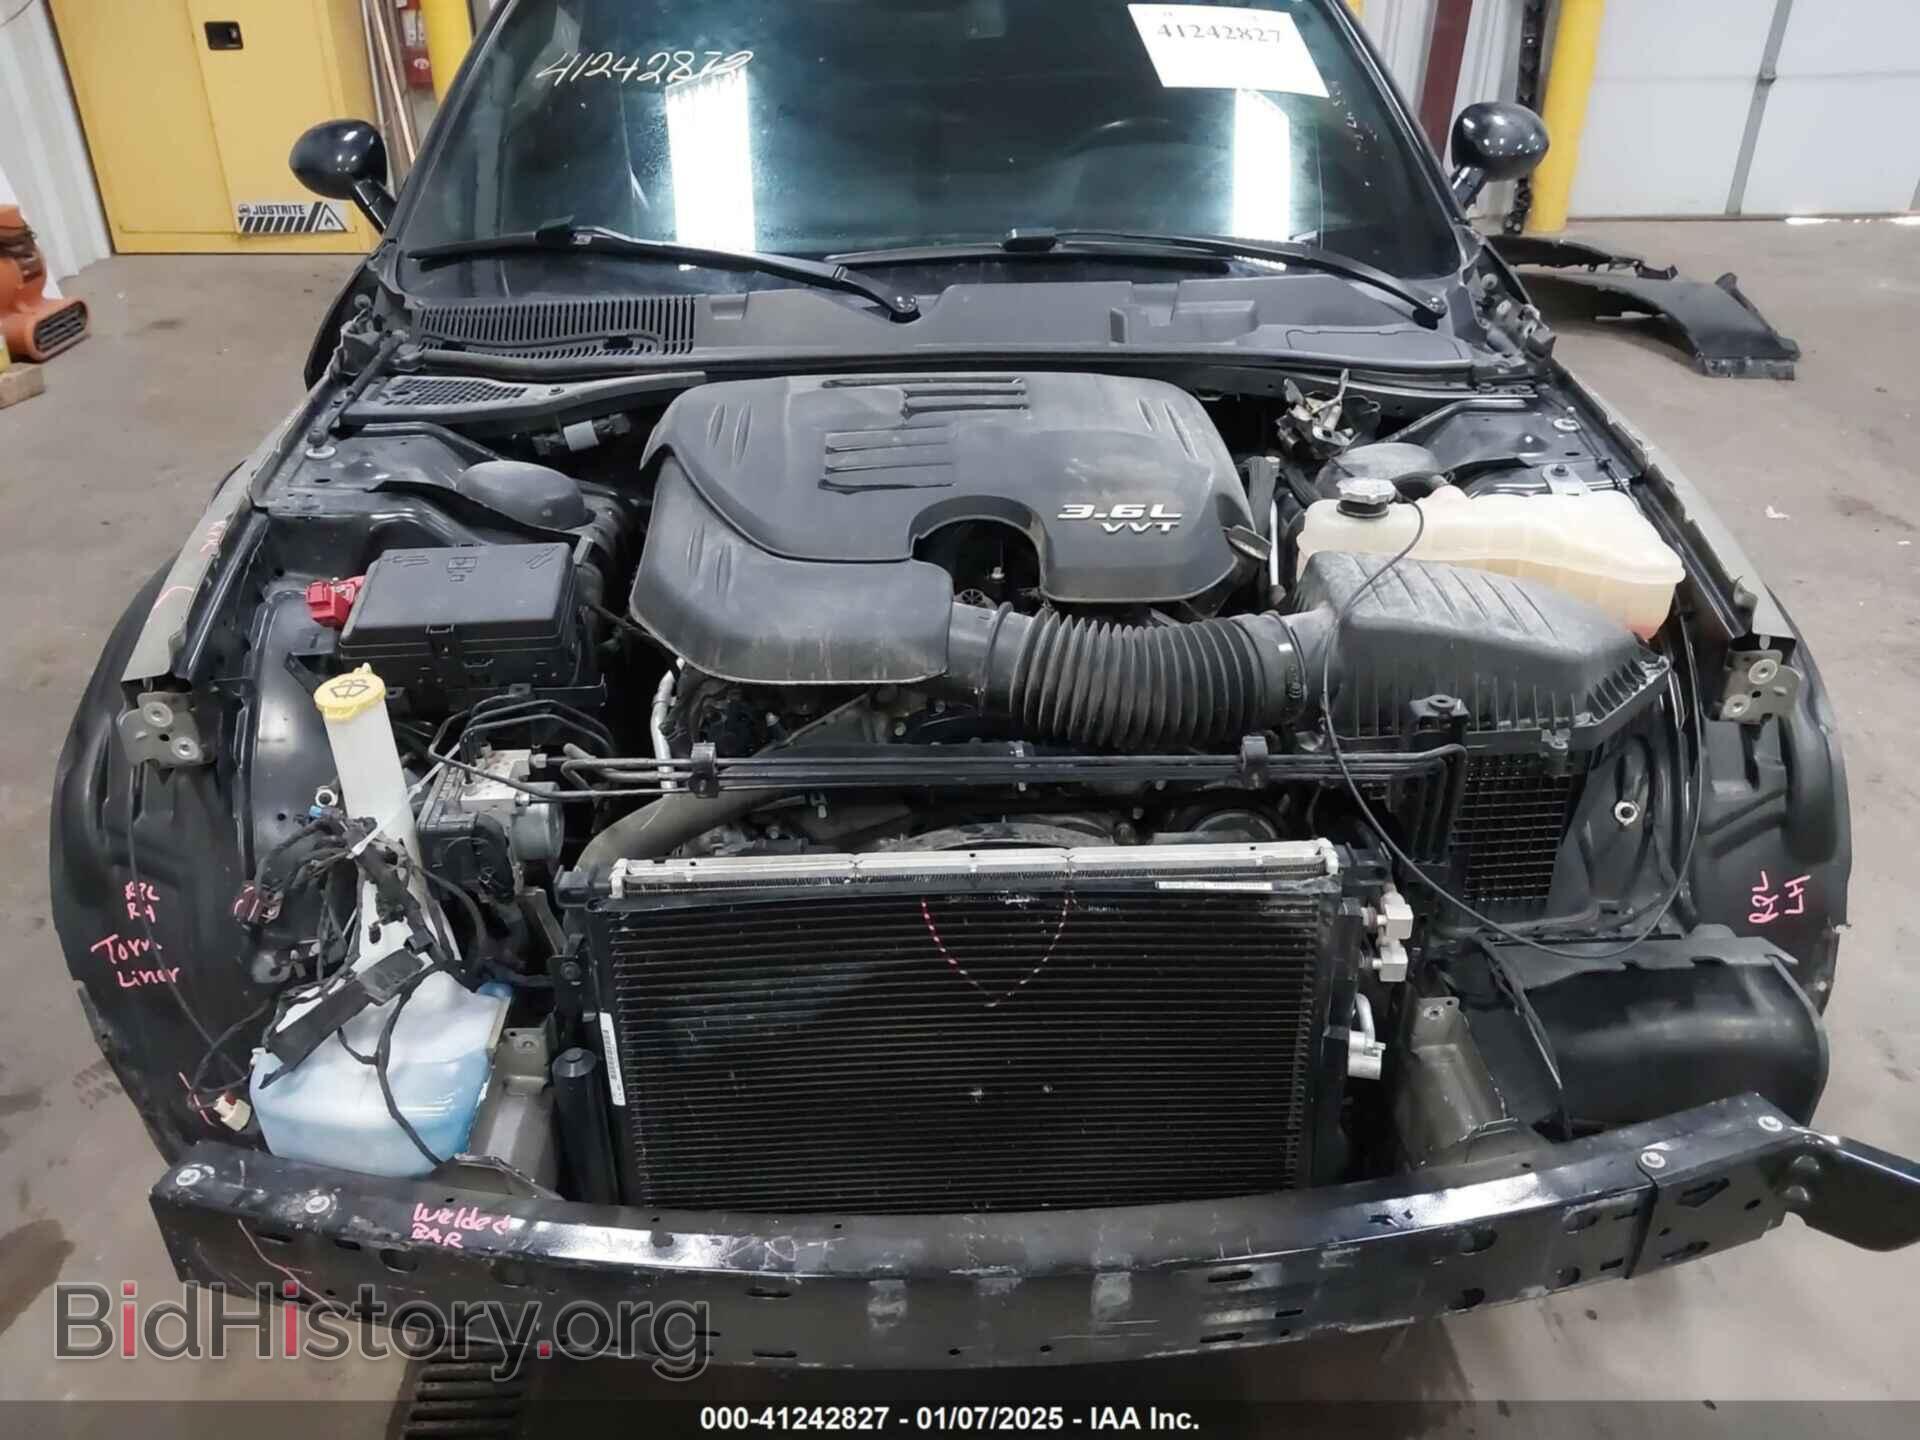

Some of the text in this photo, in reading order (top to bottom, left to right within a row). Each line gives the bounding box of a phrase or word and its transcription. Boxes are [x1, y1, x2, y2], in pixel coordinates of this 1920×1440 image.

[1157, 23, 1281, 43] 41242827
[253, 204, 305, 216] JUSTRITE
[1057, 504, 1182, 519] 3.6L
[1101, 521, 1180, 533] VVT
